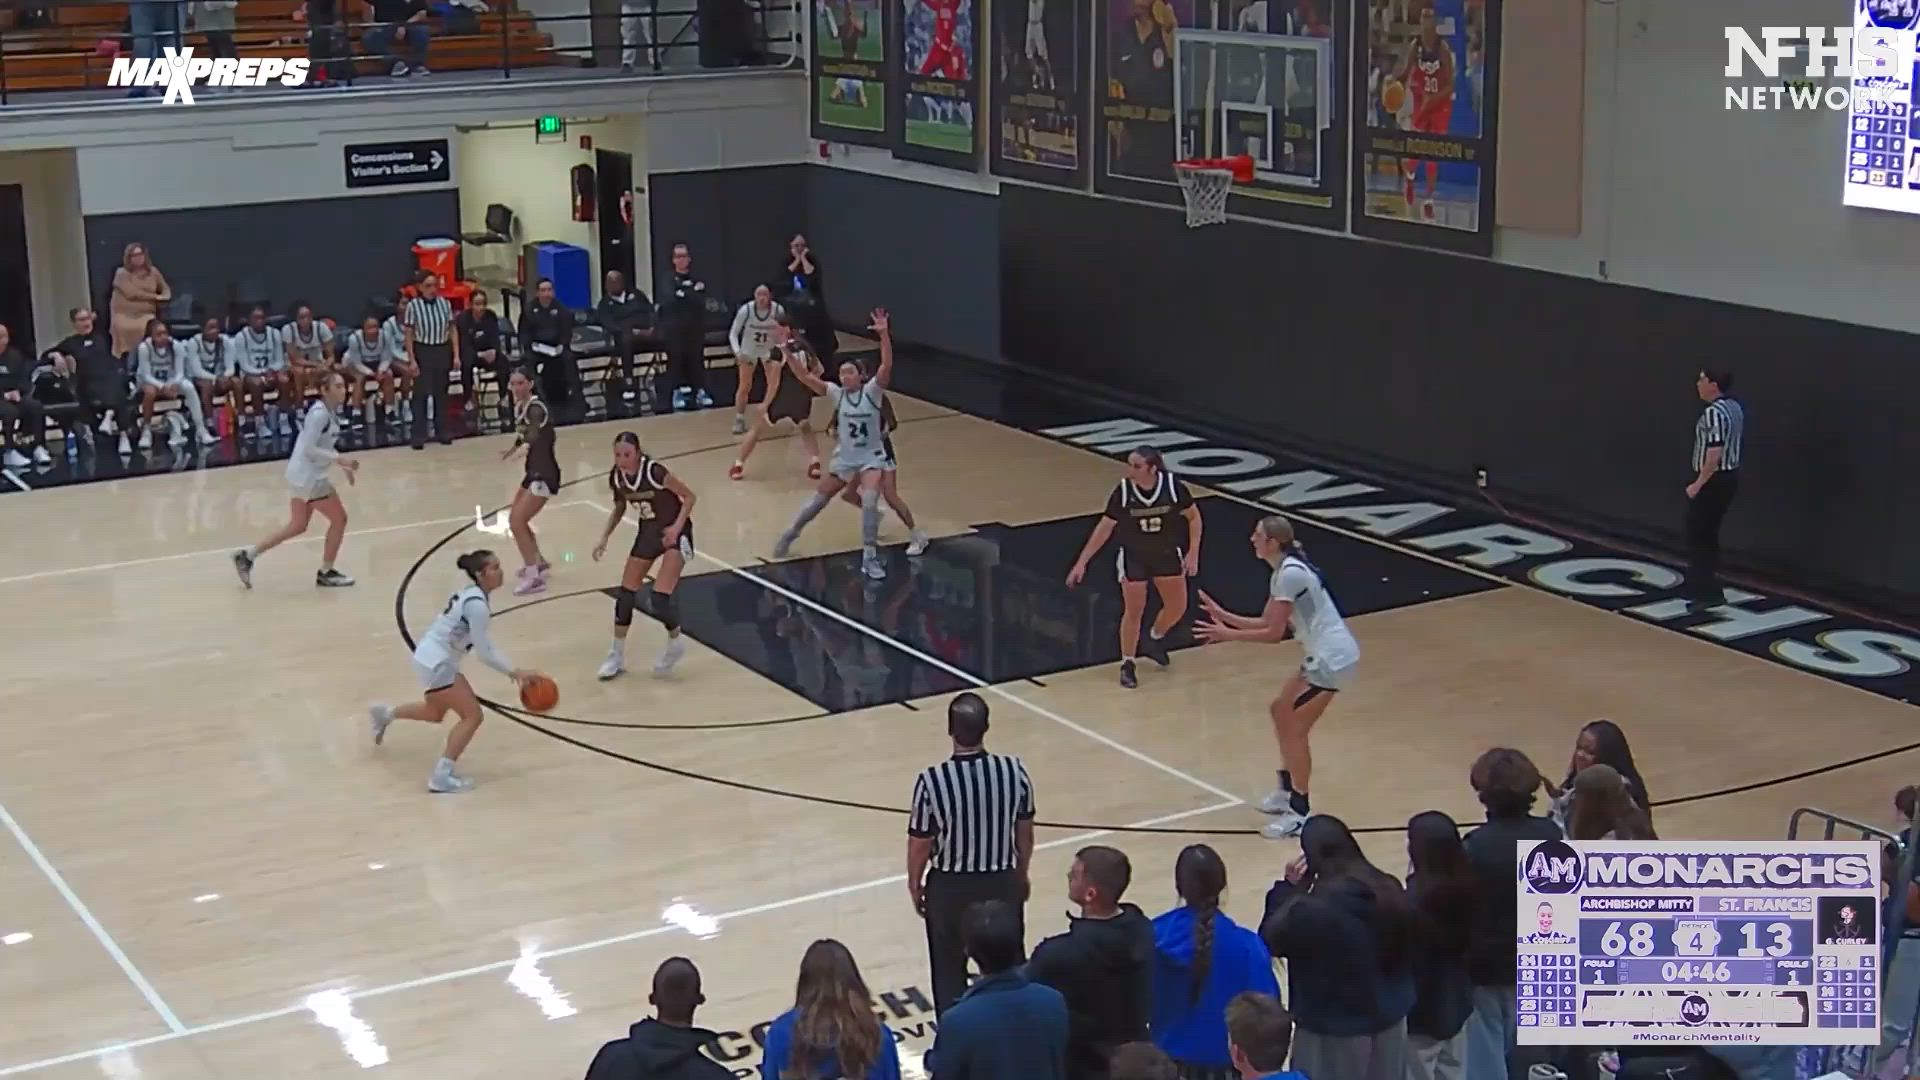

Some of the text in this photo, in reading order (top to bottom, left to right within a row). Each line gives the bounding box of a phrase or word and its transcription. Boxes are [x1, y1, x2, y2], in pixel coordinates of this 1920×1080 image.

[1878, 120, 1885, 130] 7
[1894, 122, 1902, 132] 1
[1876, 138, 1883, 148] 4
[1875, 155, 1882, 166] 2
[1892, 157, 1899, 168] 1
[1891, 175, 1898, 185] 1
[754, 332, 768, 343] 21
[848, 421, 869, 438] 24
[1041, 417, 1920, 677] MONARCHS
